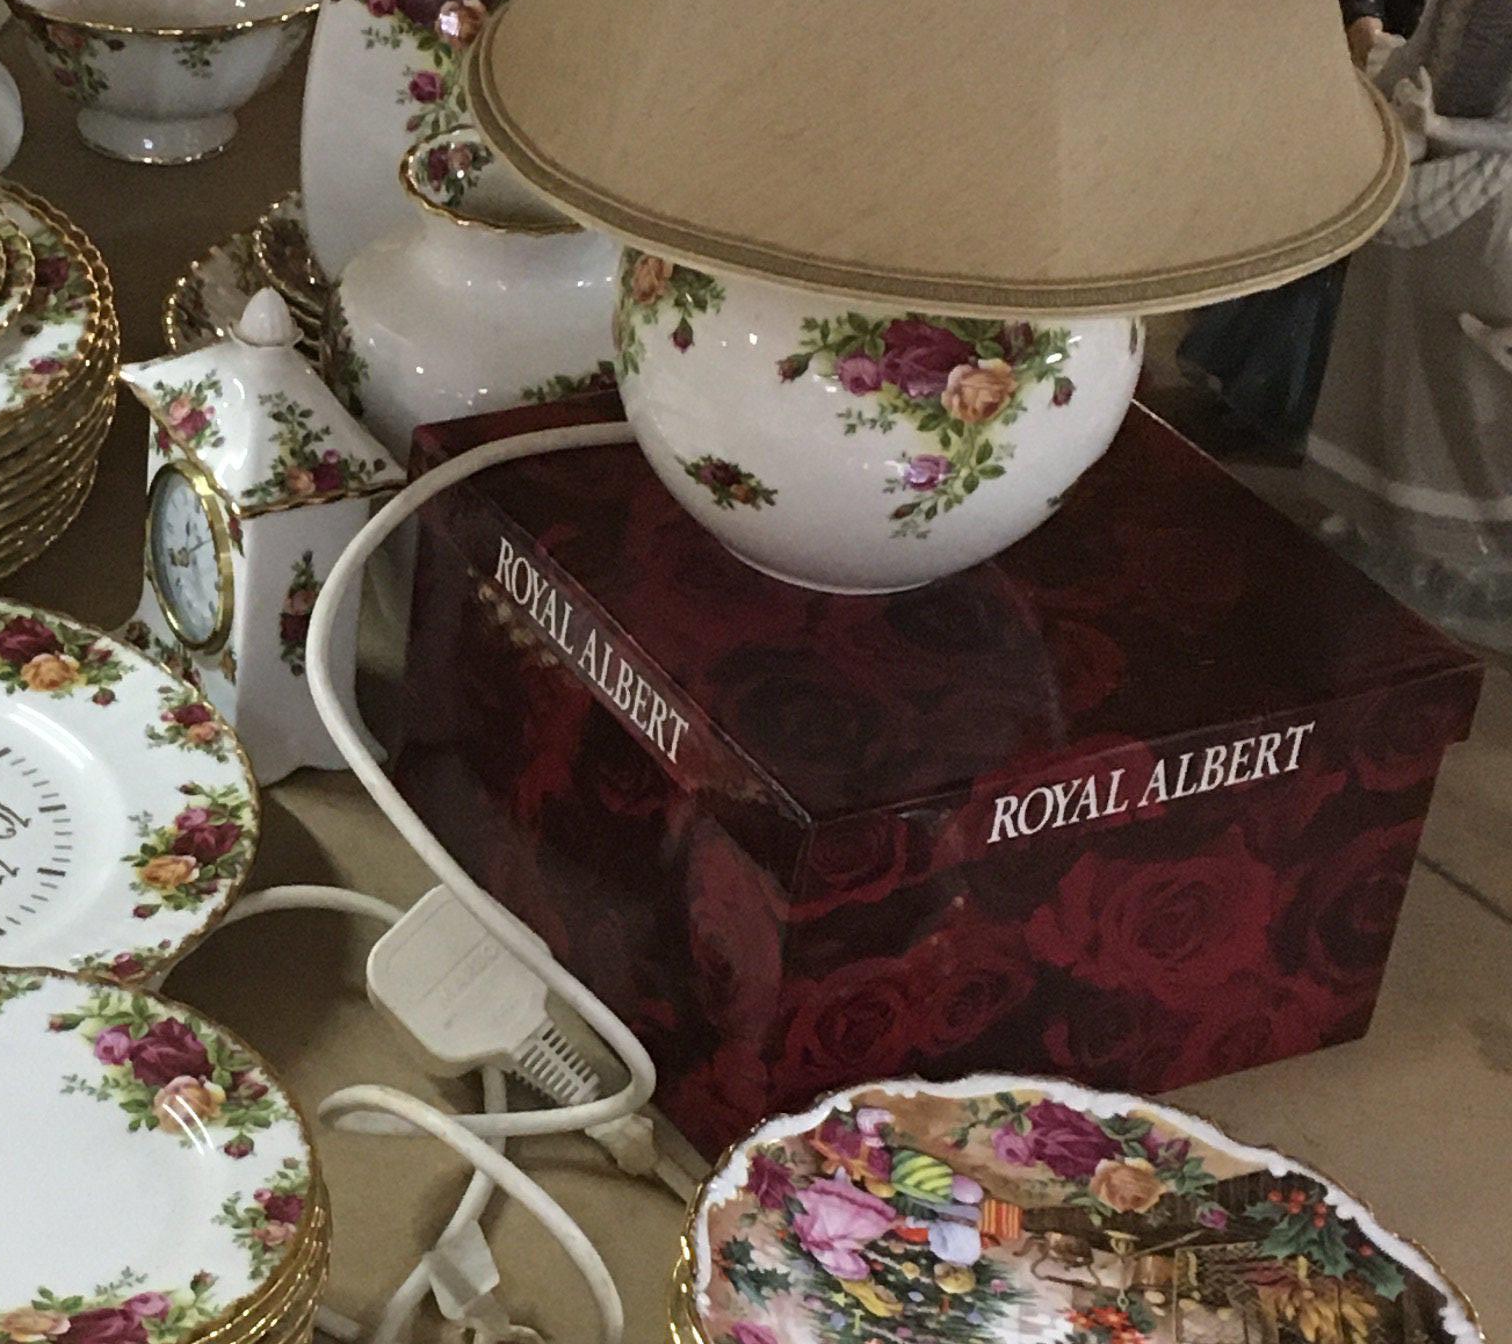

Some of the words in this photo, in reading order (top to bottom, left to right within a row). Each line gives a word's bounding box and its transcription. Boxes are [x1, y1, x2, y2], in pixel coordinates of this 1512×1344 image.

[495, 536, 573, 655] ROYAL
[577, 629, 689, 764] ALBERT
[987, 768, 1129, 844] ROYAL
[1137, 721, 1317, 808] ALBERT
